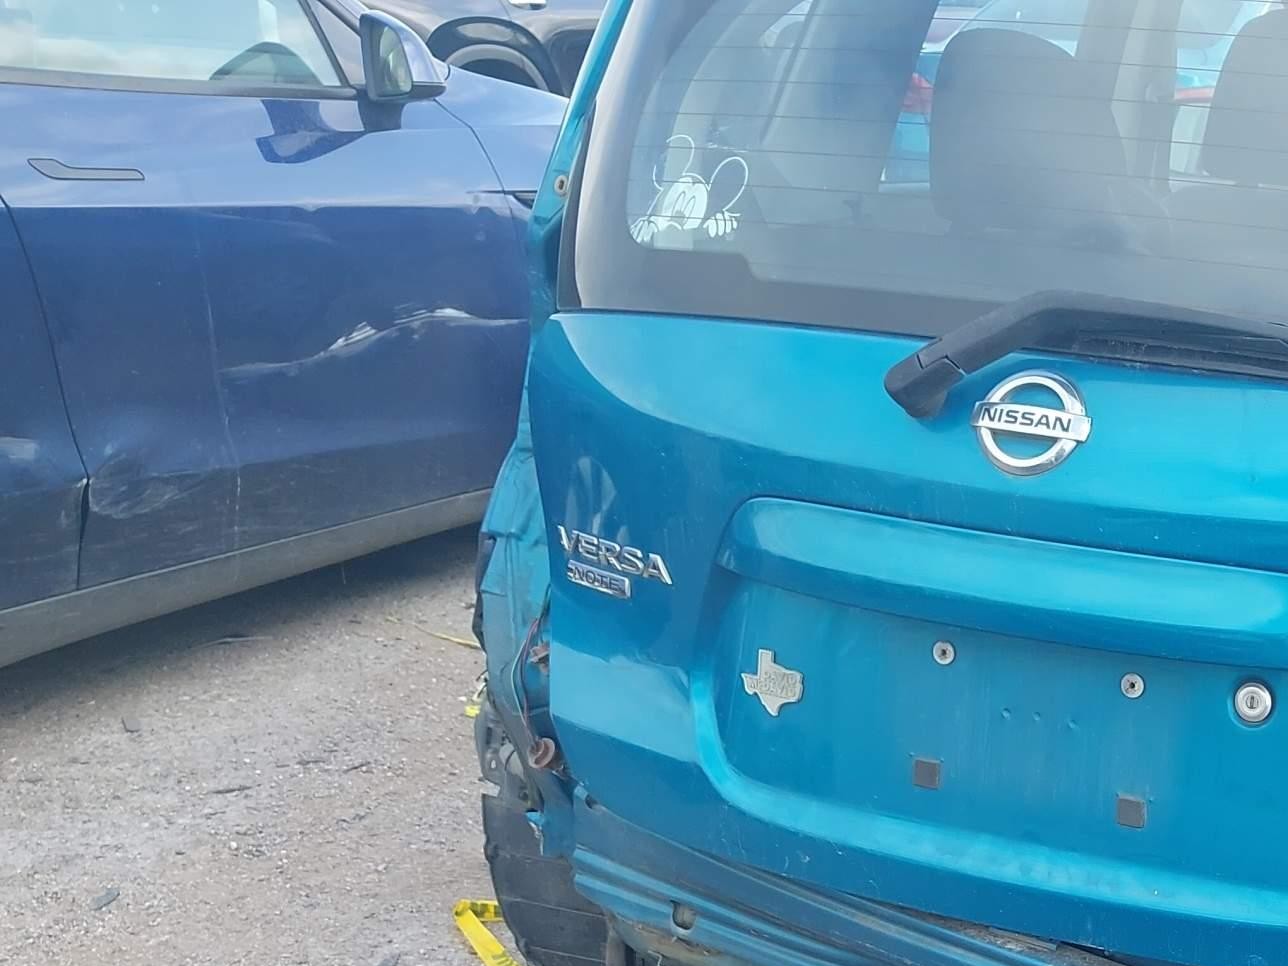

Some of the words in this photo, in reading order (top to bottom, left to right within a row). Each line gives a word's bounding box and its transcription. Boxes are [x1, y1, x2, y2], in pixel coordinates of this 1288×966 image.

[981, 406, 1072, 433] NISSAN
[557, 525, 673, 585] VERSA
[573, 565, 623, 592] NOTE
